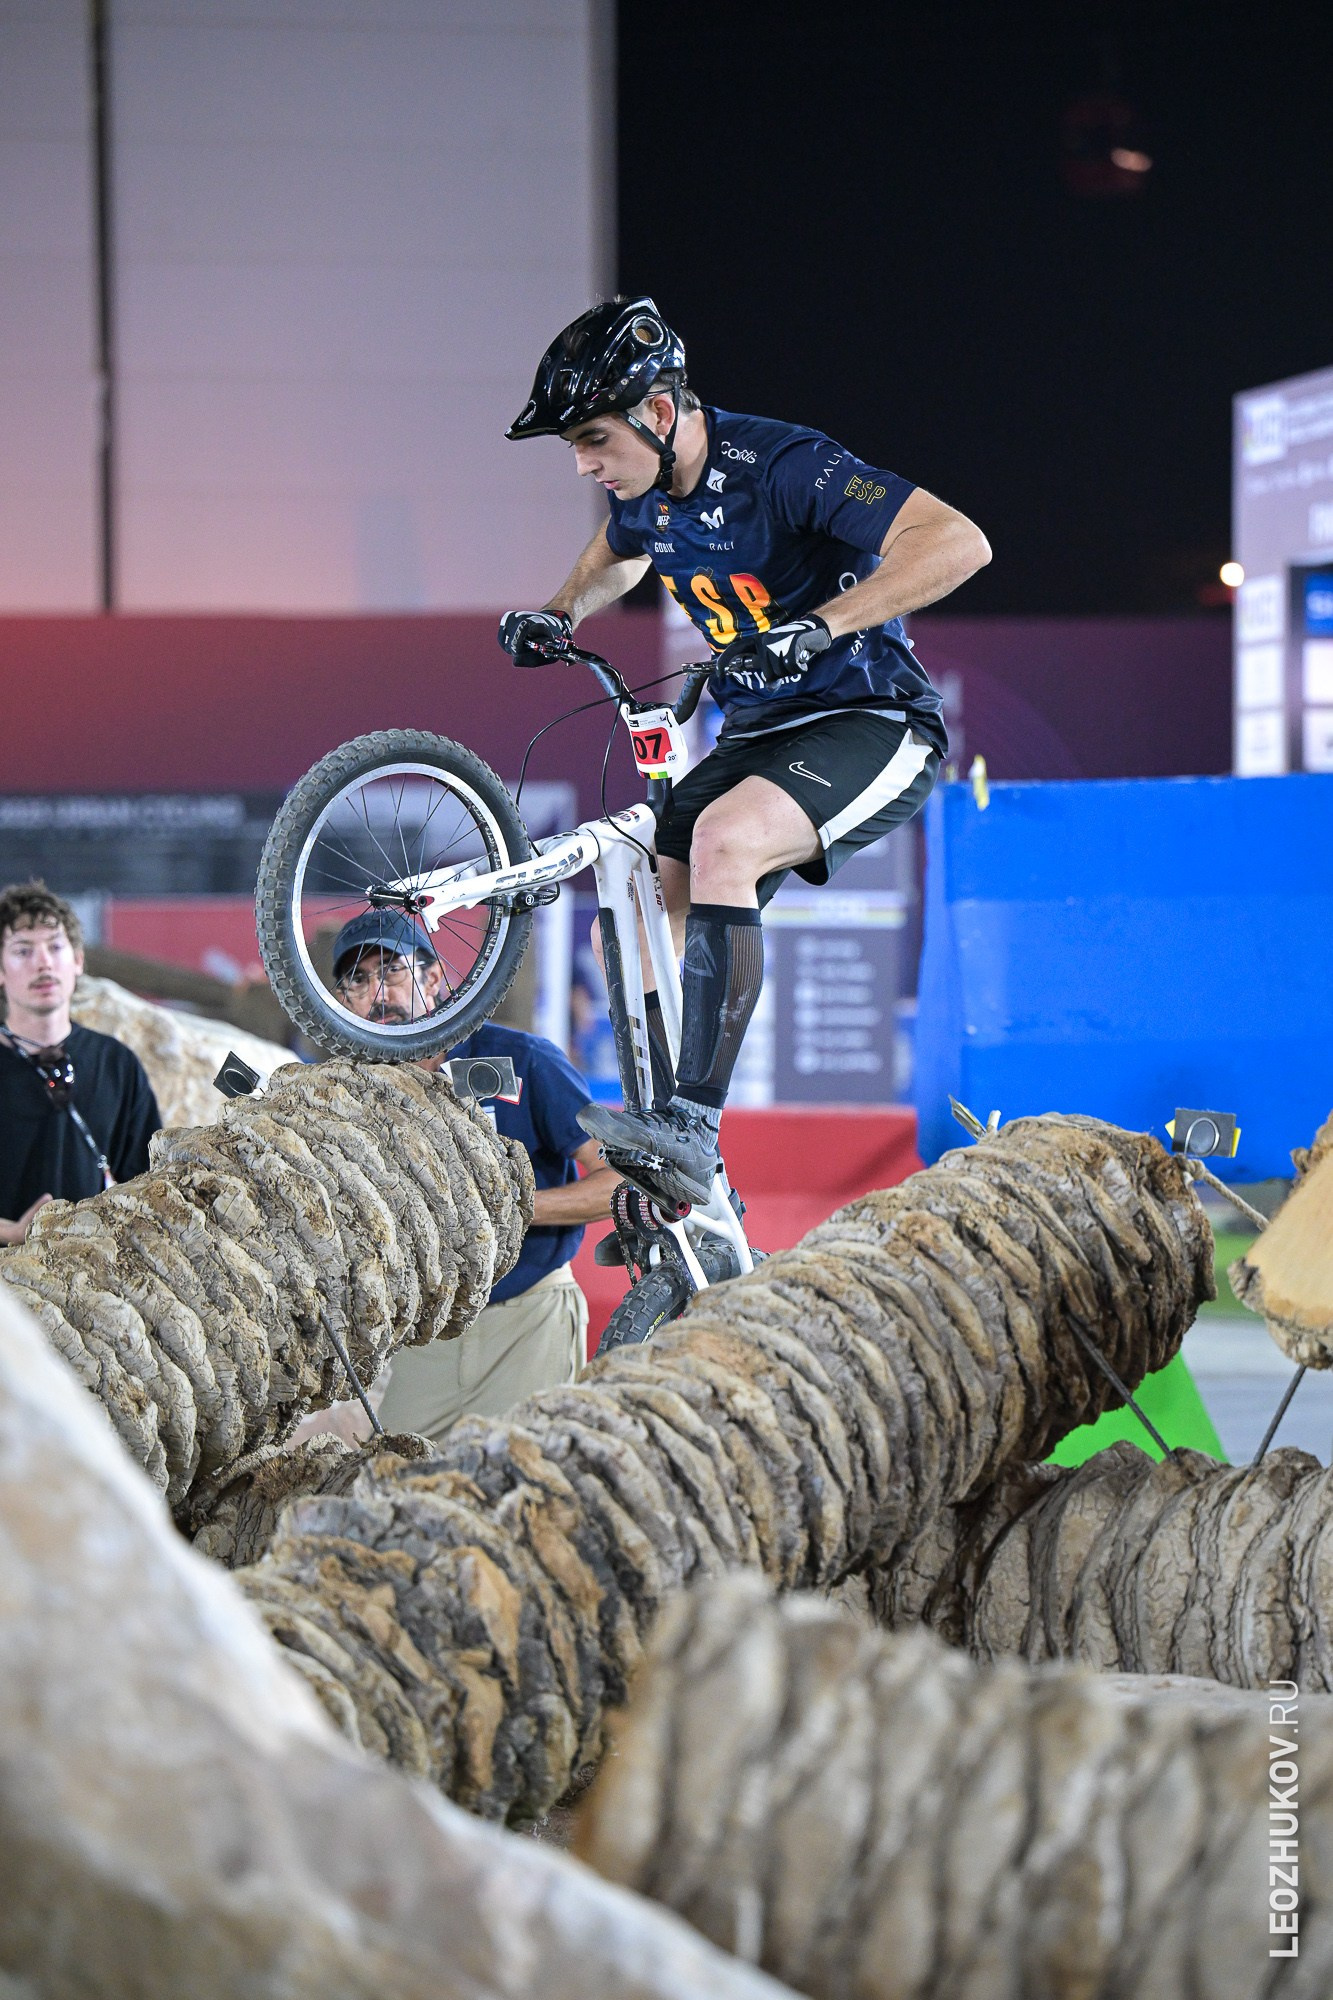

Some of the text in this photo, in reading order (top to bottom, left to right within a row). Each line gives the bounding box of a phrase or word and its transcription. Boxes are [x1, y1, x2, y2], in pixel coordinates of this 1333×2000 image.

[815, 453, 843, 490] RALI
[844, 475, 886, 505] ESP
[709, 541, 734, 551] RALI
